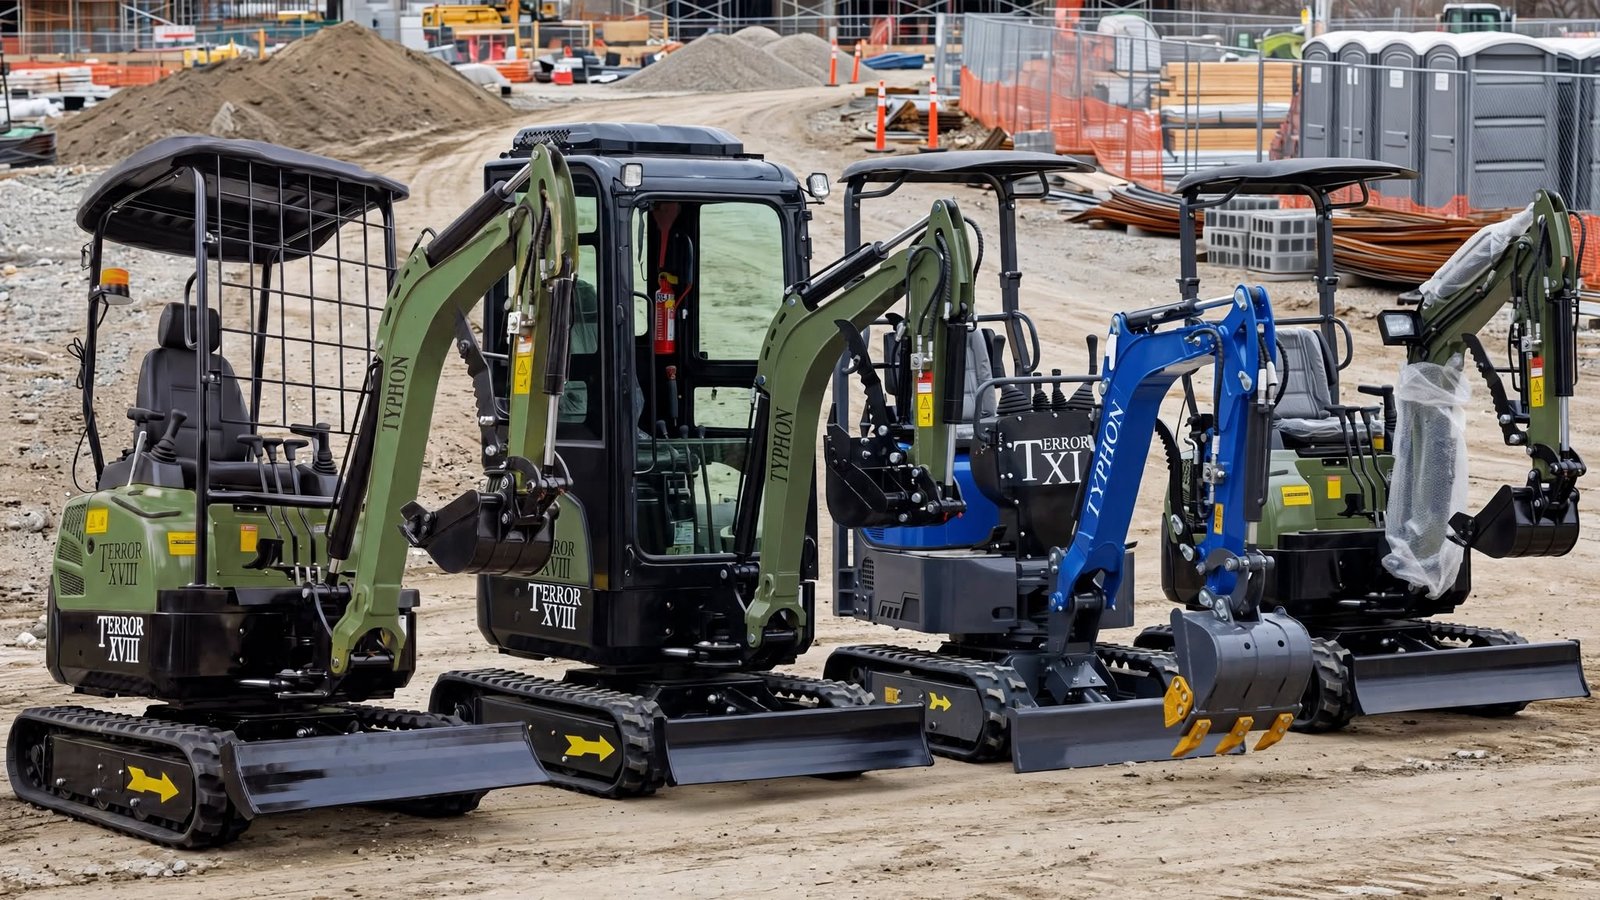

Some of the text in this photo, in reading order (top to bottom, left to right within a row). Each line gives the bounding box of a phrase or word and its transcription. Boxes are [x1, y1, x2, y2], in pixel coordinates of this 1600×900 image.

[382, 354, 410, 432] TYPHON
[770, 406, 793, 483] TYPHON
[1013, 436, 1090, 482] TERROR
[1086, 399, 1126, 518] TYPHON
[1041, 450, 1082, 485] XI
[99, 541, 143, 573] TERROR
[553, 539, 575, 557] ROR
[108, 562, 139, 586] XVIII
[527, 582, 582, 612] TERROR
[96, 615, 145, 648] TERROR
[541, 602, 577, 630] XVIII
[108, 636, 141, 664] XVIII
